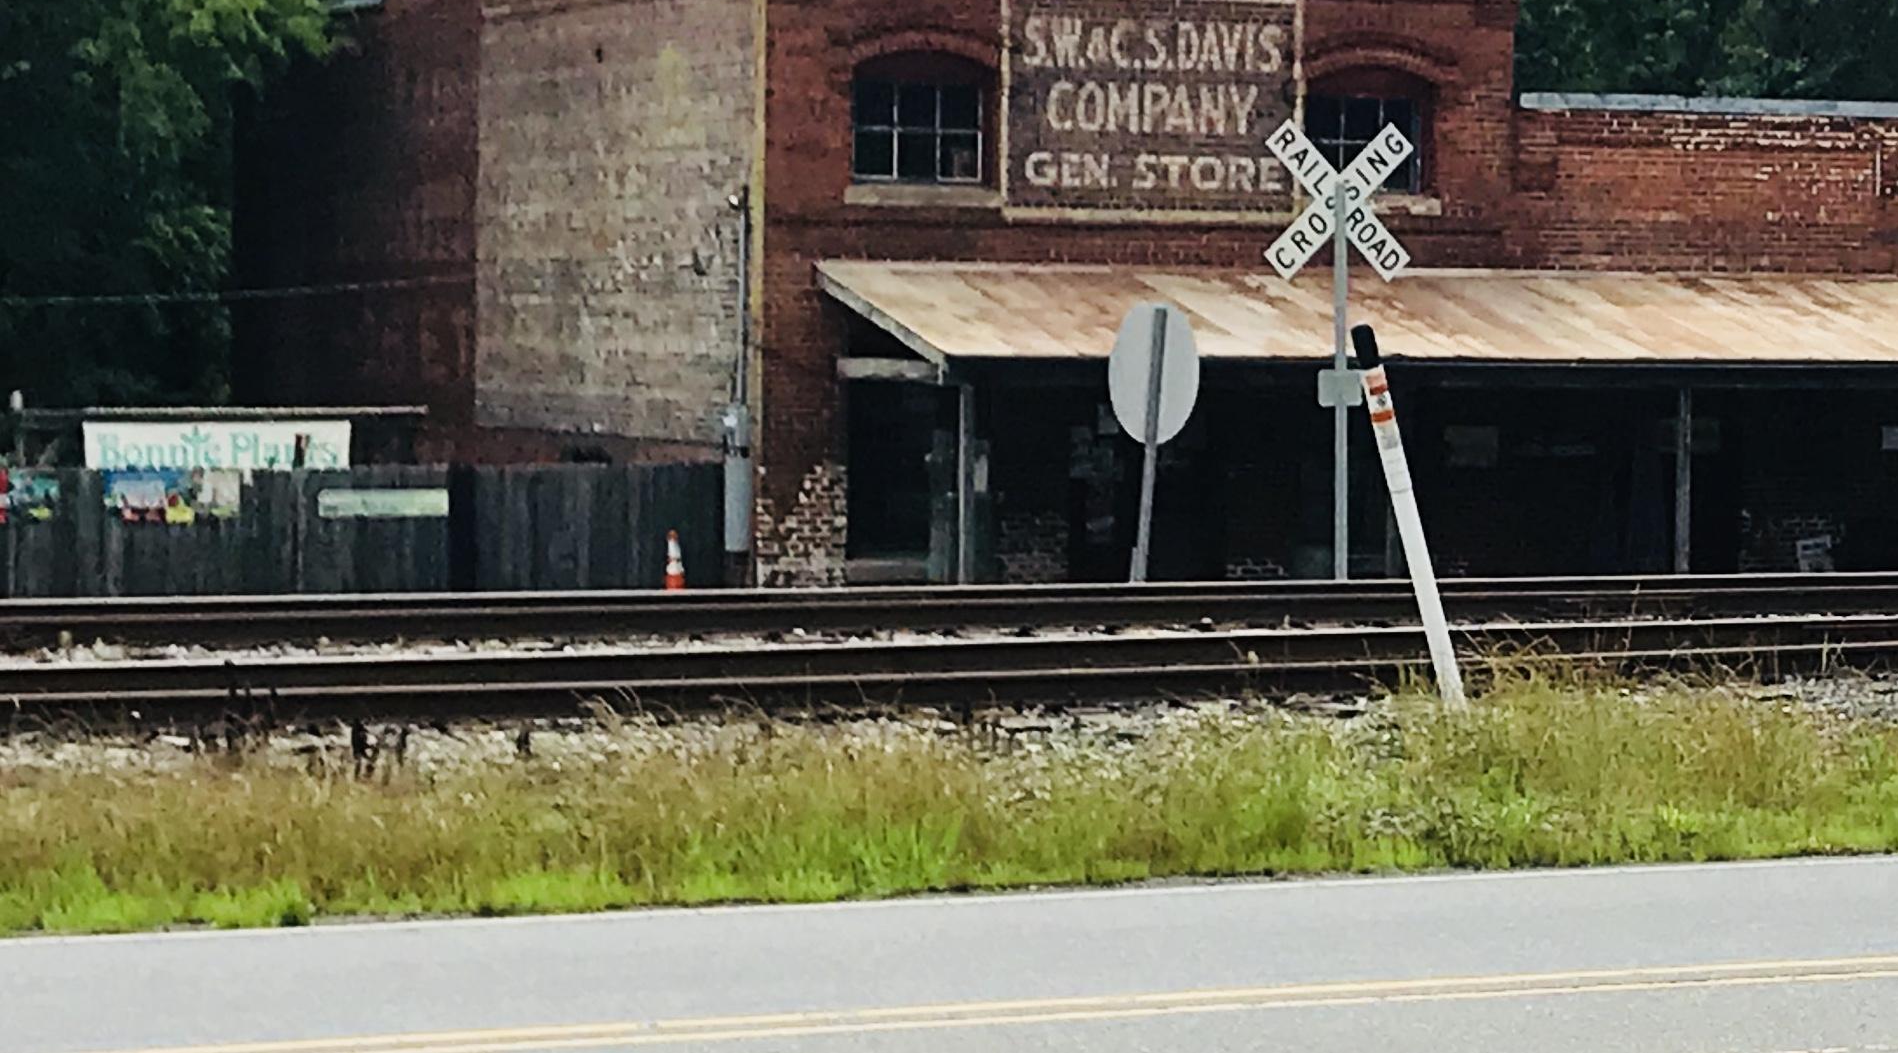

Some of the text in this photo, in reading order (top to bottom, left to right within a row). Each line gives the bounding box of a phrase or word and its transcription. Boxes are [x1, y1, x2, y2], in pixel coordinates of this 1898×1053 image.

[1047, 81, 1258, 136] COMPANY
[1025, 151, 1283, 192] GEN. STORE
[98, 431, 221, 468] Bonnie
